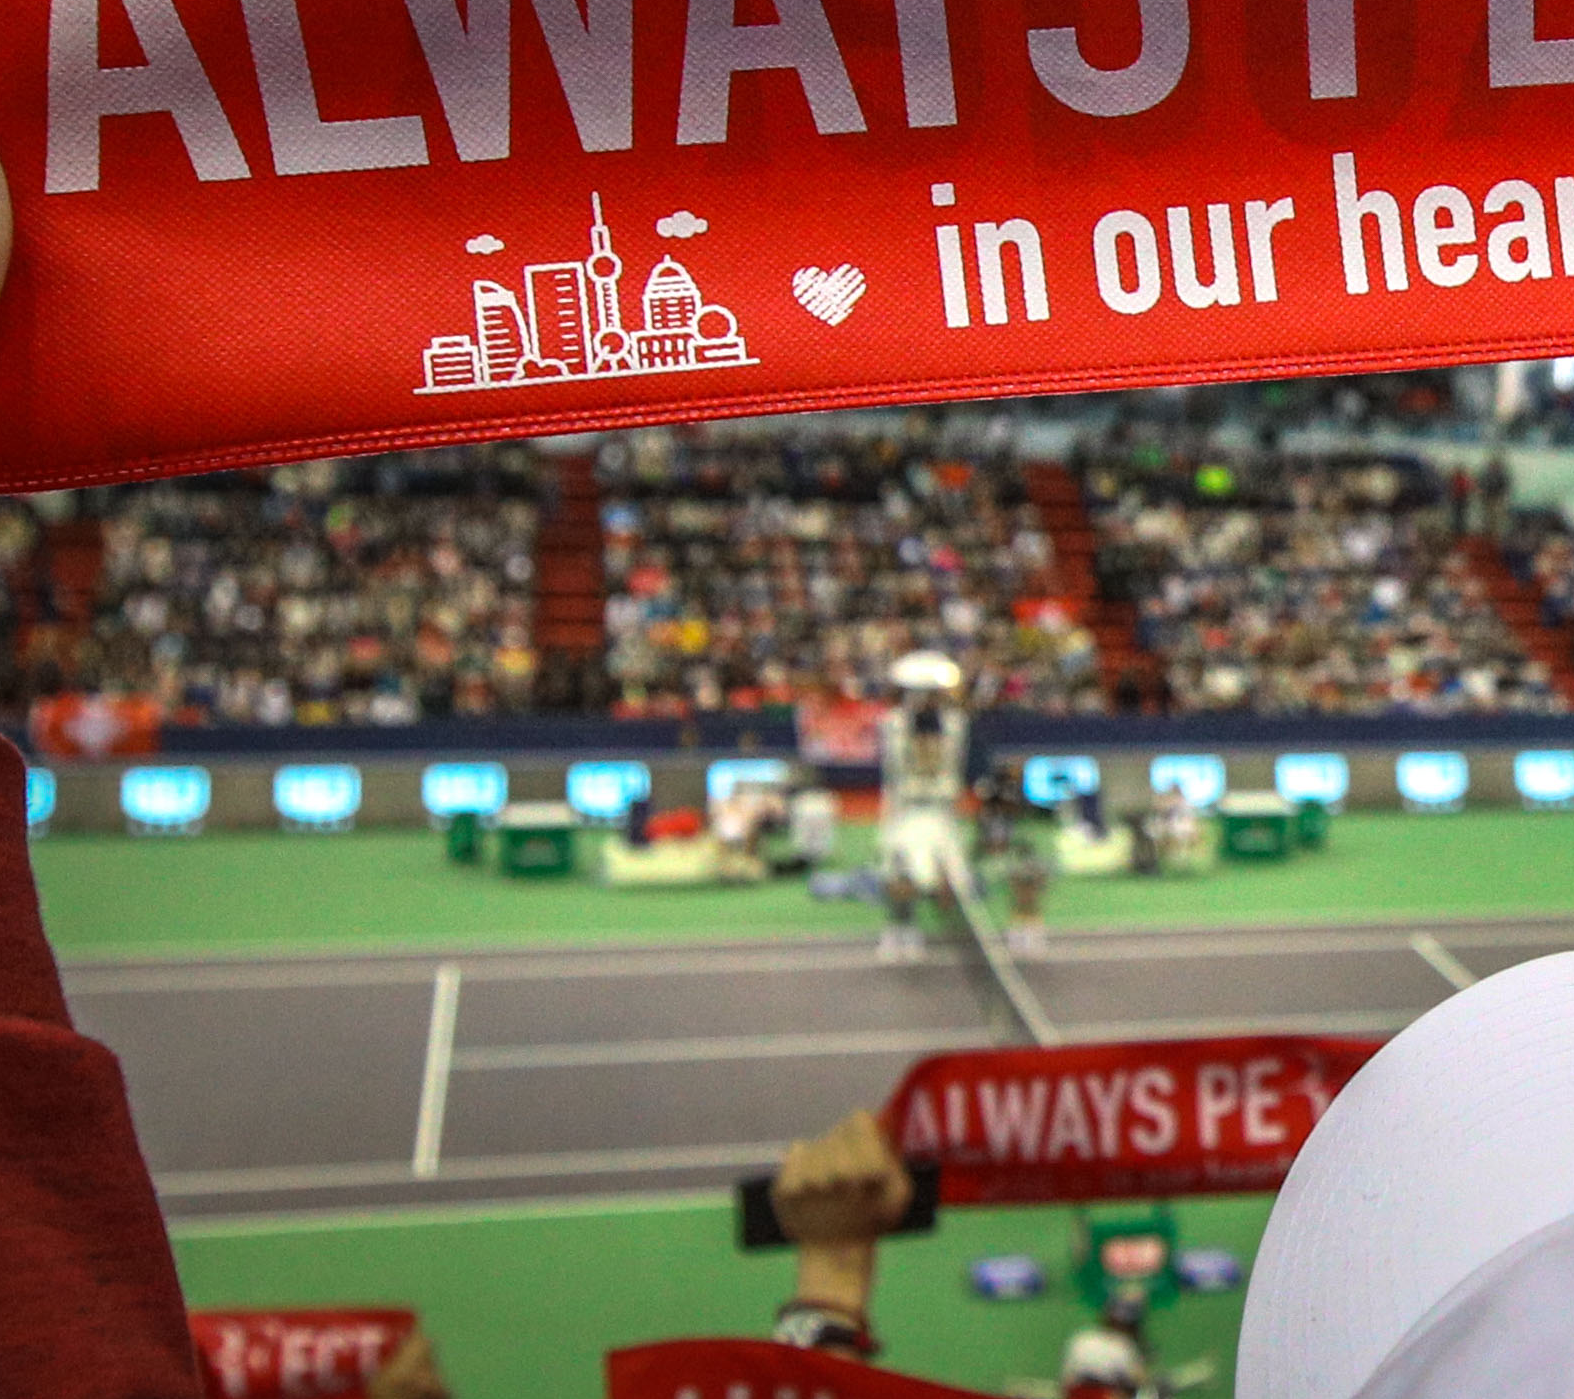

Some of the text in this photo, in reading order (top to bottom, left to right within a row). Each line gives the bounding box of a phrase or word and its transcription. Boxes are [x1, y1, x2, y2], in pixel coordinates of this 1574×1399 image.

[931, 181, 1050, 329] in
[1092, 193, 1297, 314] our
[900, 1064, 1179, 1164] ALWAYS
